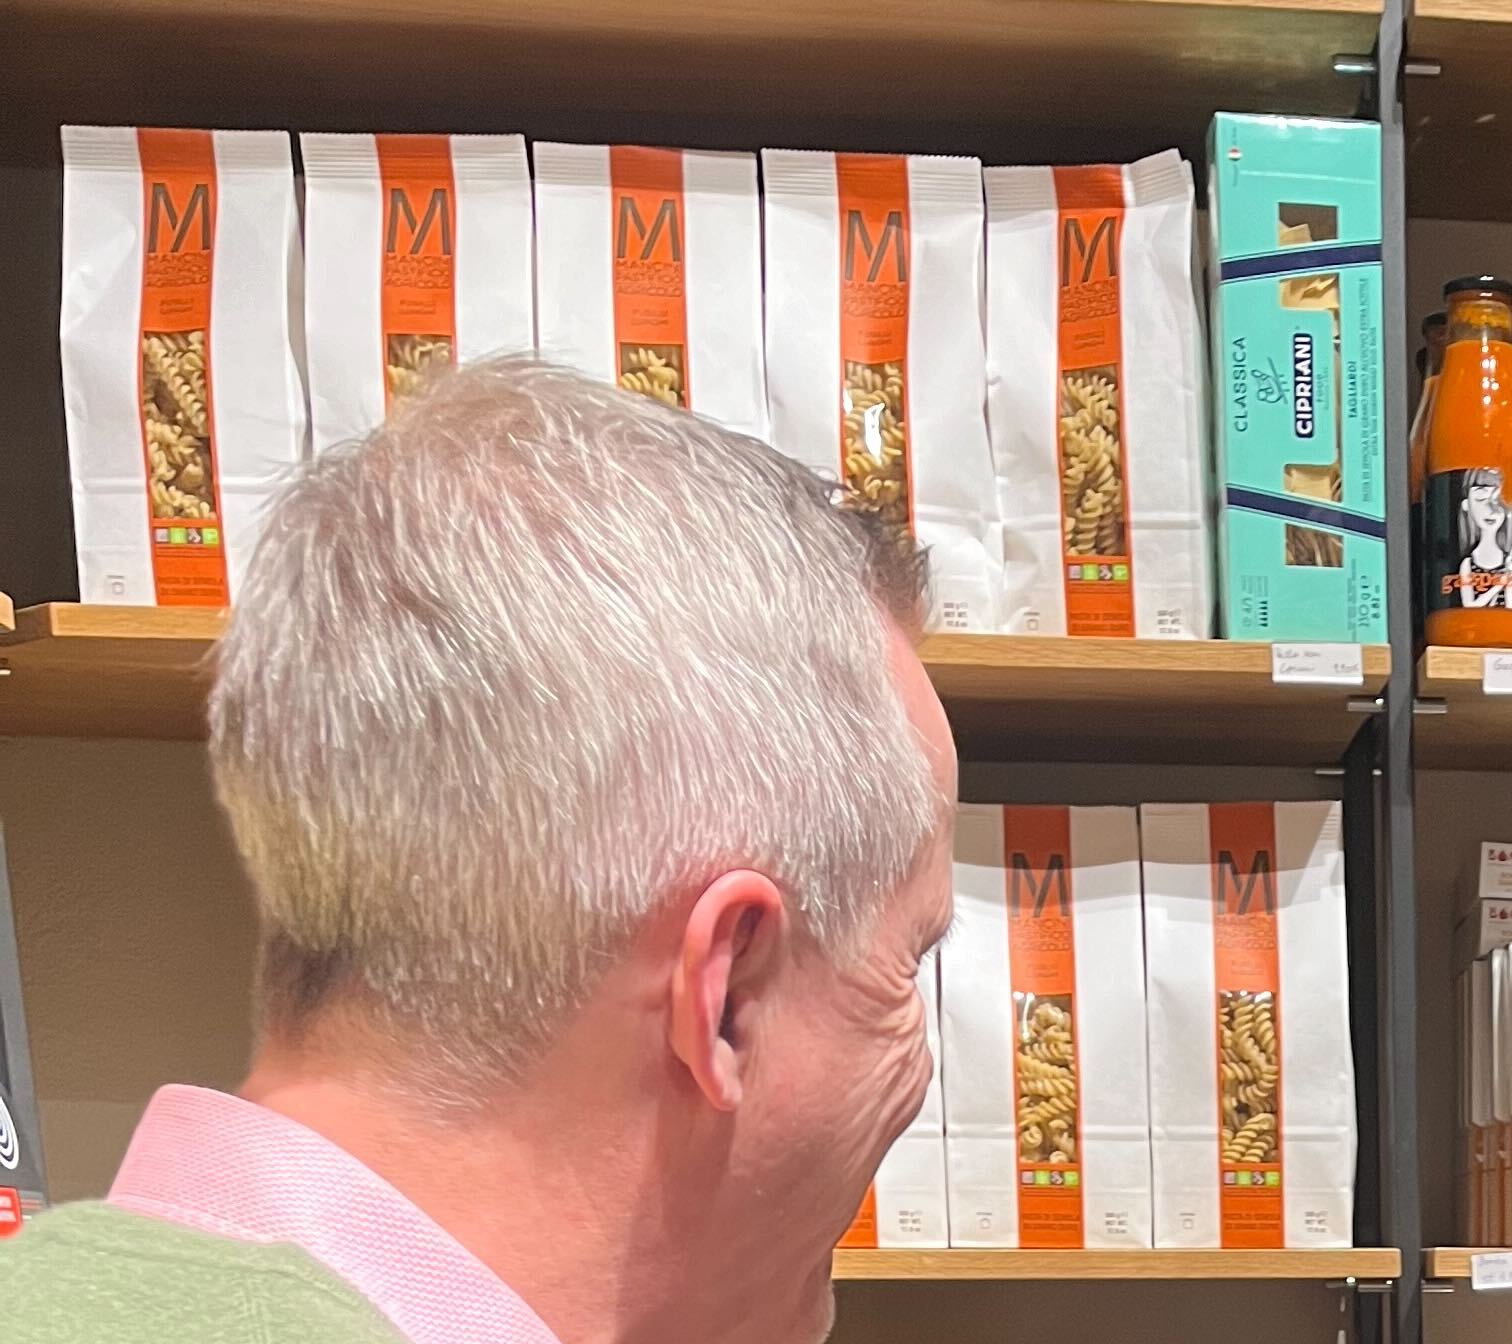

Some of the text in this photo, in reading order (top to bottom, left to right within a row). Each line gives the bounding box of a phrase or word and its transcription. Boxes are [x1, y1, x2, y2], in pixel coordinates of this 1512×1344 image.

[148, 183, 210, 252] M
[386, 188, 451, 255] M
[617, 196, 680, 261] M
[845, 210, 906, 282] M
[1063, 216, 1116, 286] M
[1232, 336, 1247, 432] CLASSICA
[1295, 336, 1313, 436] CIPRIANI
[1012, 852, 1070, 918] M
[1218, 850, 1273, 915] M
